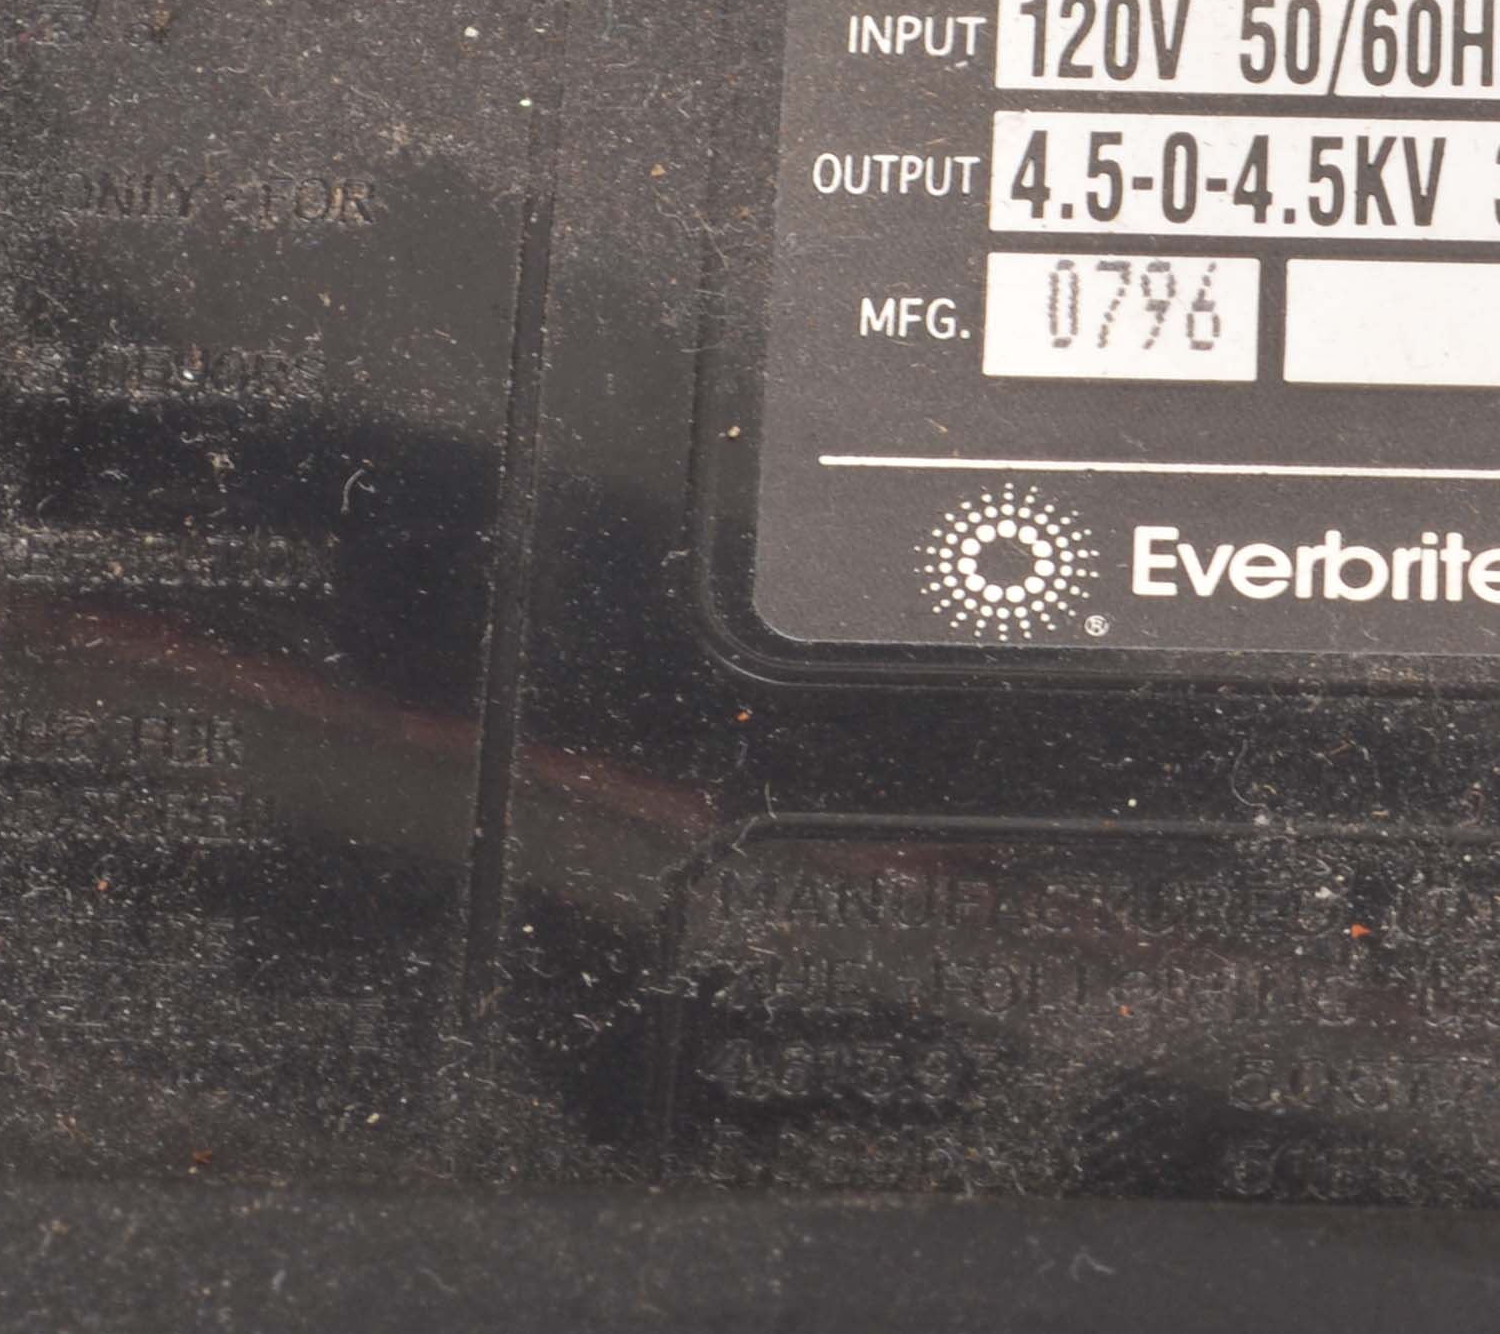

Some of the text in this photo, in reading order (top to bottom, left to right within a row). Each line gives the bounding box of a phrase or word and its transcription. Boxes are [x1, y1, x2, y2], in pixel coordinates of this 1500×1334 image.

[847, 14, 988, 58] INPUT
[811, 152, 981, 196] OUTPUT
[1010, 129, 1448, 227] 4.5-0-4.5KV
[858, 258, 1221, 351] MFG. 0796
